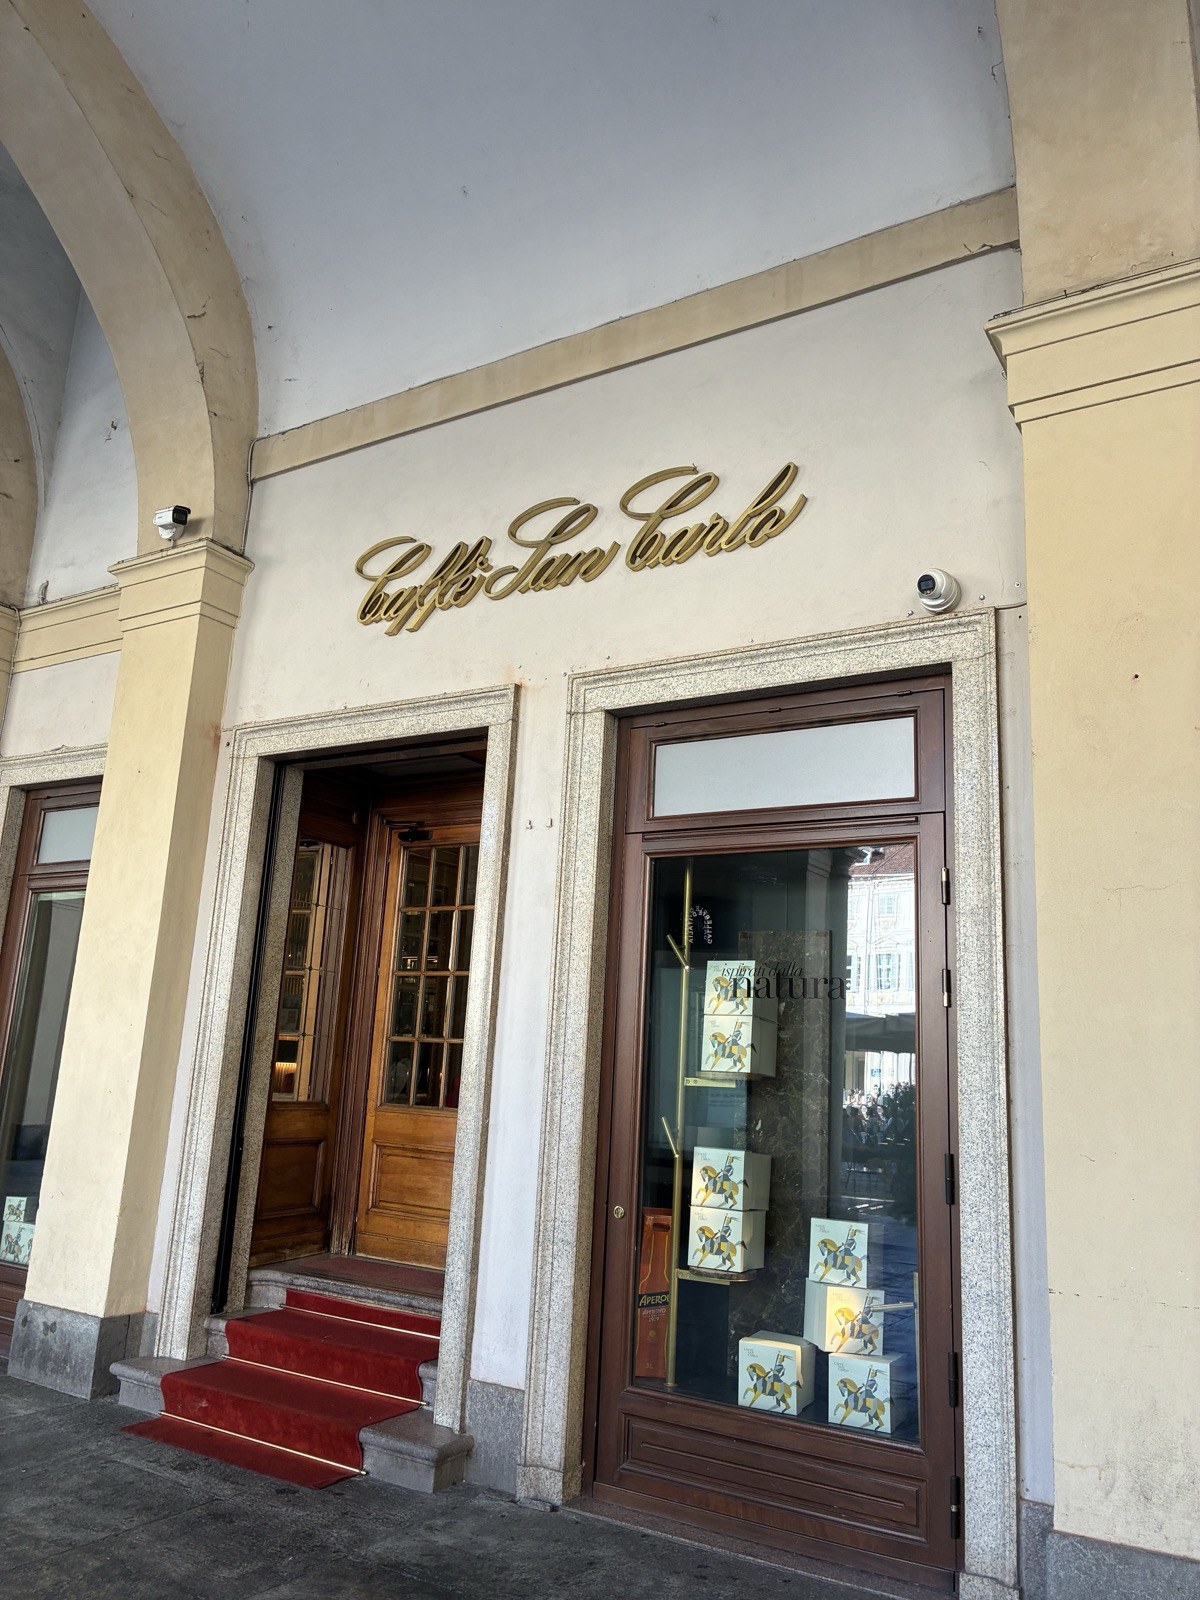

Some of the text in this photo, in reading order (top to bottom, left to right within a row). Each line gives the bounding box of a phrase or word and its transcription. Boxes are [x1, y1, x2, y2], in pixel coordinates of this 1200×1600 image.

[484, 497, 620, 600] San
[620, 461, 807, 572] Carlo
[721, 963, 765, 980] ispirati
[768, 962, 803, 977] dalla
[730, 975, 846, 1000] natura
